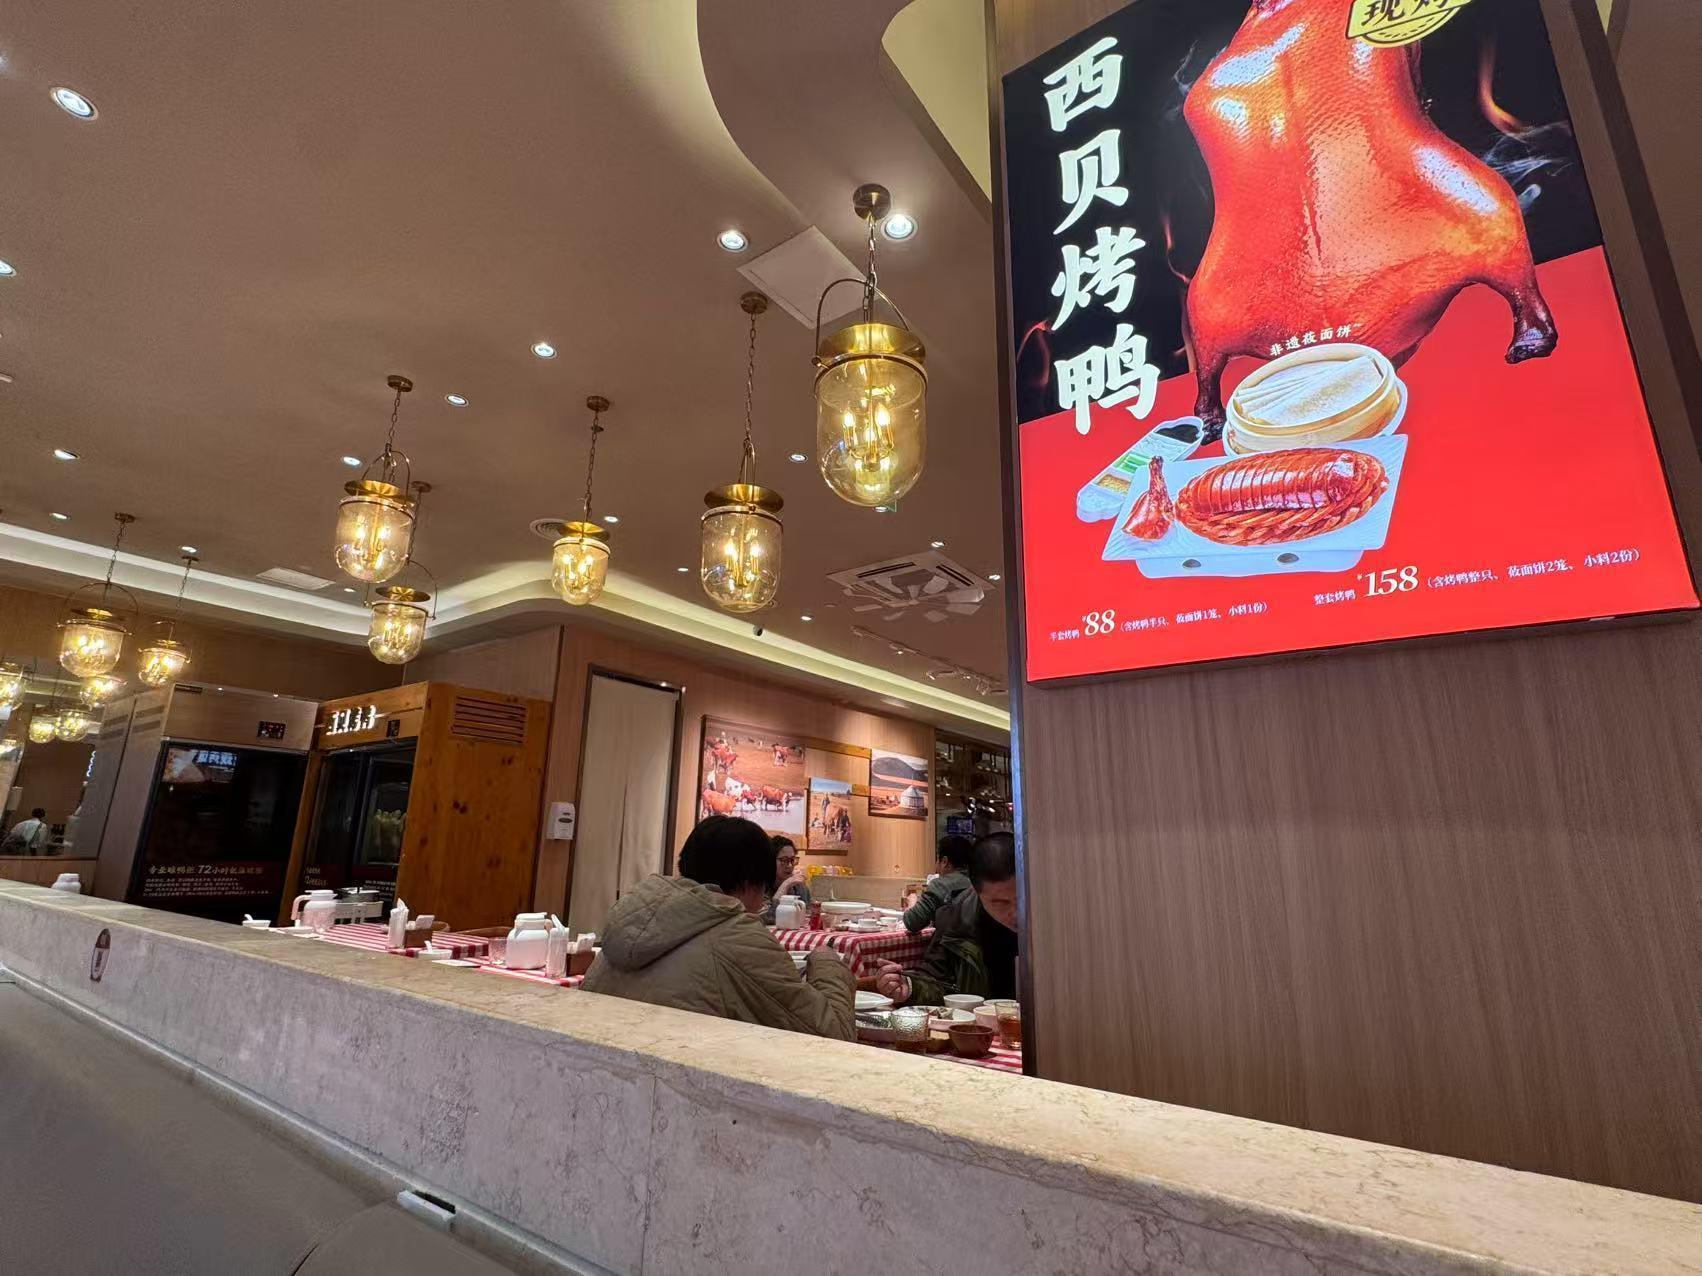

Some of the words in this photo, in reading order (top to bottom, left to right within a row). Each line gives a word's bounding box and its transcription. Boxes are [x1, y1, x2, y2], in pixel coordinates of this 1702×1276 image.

[1043, 36, 1160, 435] 西贝烤鸭
[1270, 324, 1352, 356] 非遗莜面饼
[1314, 589, 1356, 605] 整套烤鸭
